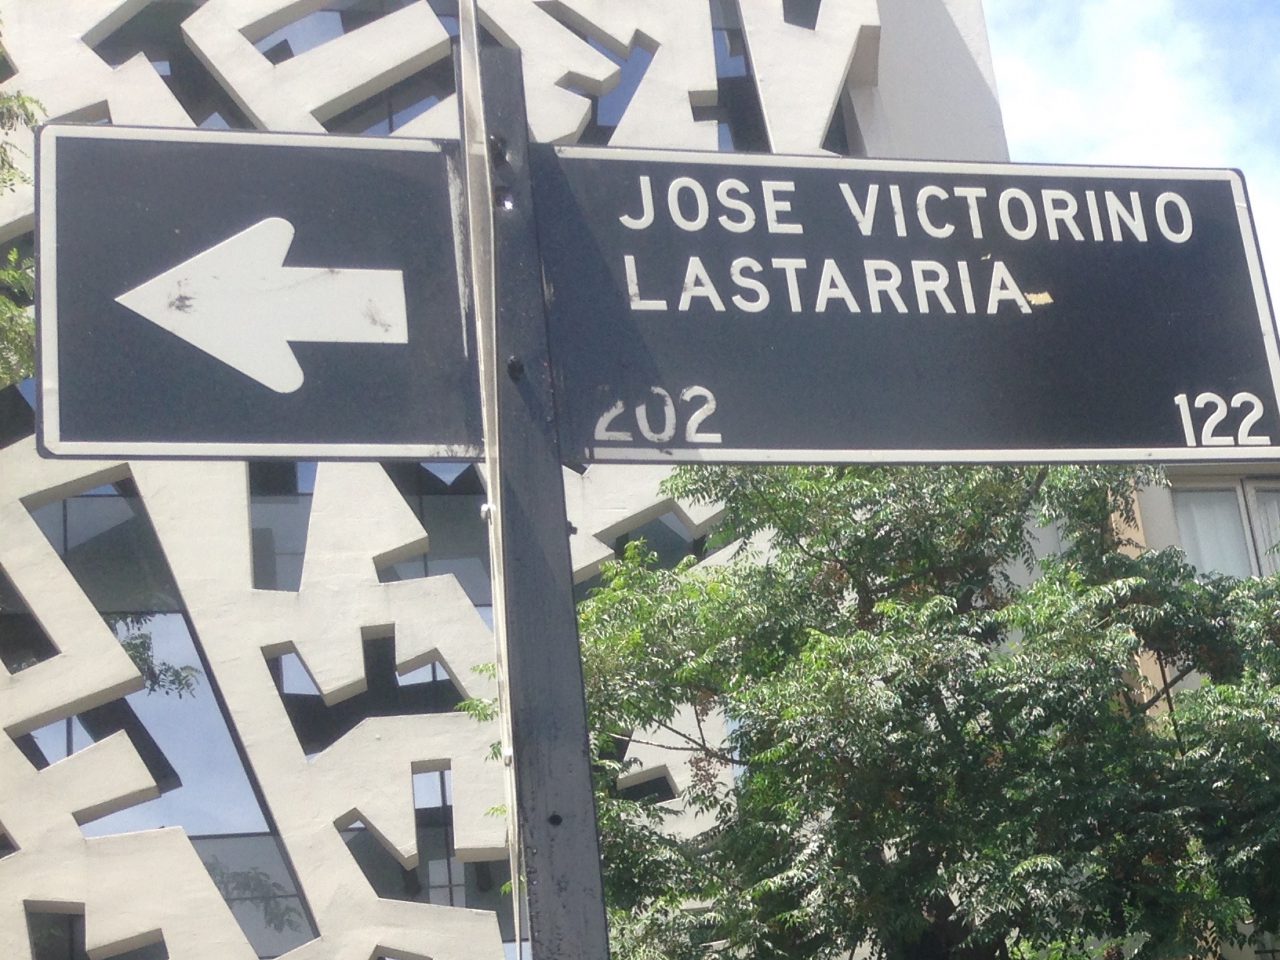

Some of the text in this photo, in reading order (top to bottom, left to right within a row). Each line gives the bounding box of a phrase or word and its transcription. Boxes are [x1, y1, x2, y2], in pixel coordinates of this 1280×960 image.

[619, 175, 1193, 243] JOSE VICTORINO
[624, 255, 1032, 314] LASTARRIA
[593, 385, 722, 443] 202
[1173, 391, 1271, 447] 122
